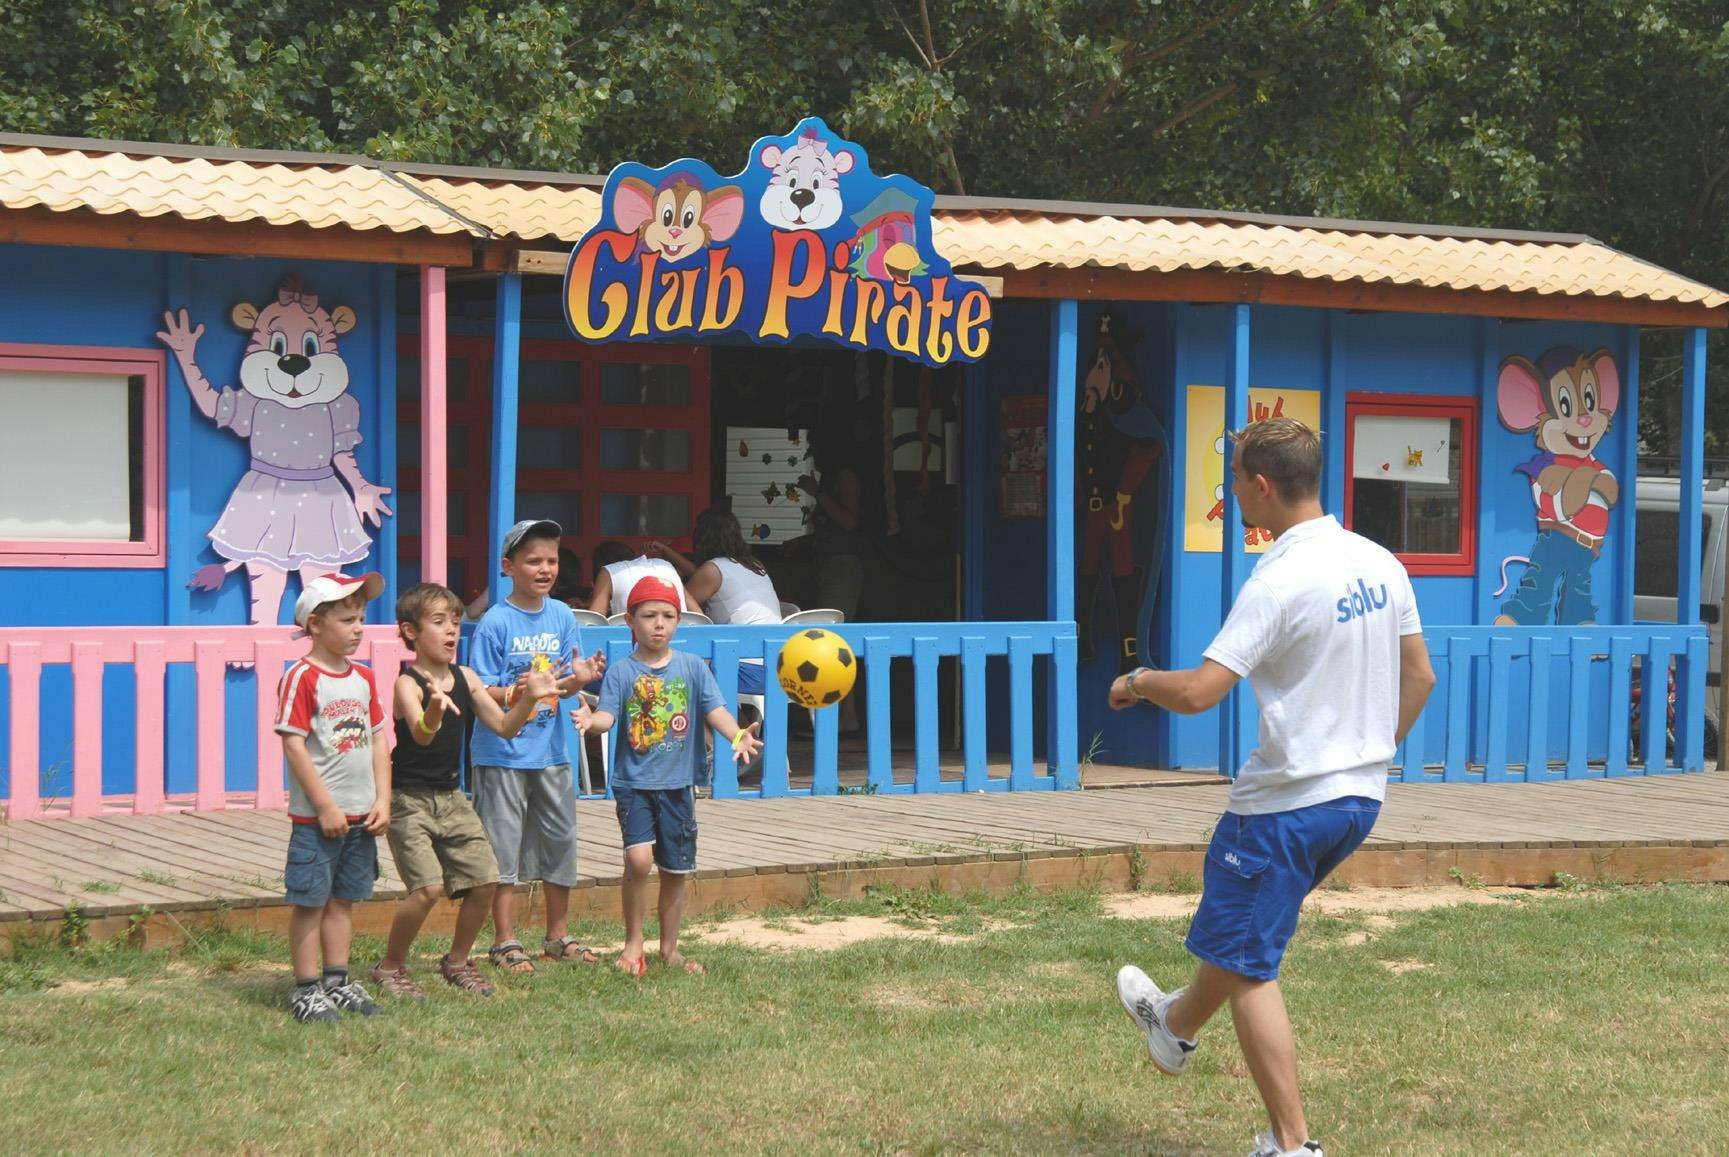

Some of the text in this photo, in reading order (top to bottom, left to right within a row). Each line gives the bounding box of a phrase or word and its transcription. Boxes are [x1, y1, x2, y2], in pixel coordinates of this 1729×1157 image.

[568, 229, 992, 364] Club Pirate
[511, 632, 561, 652] NARUTO
